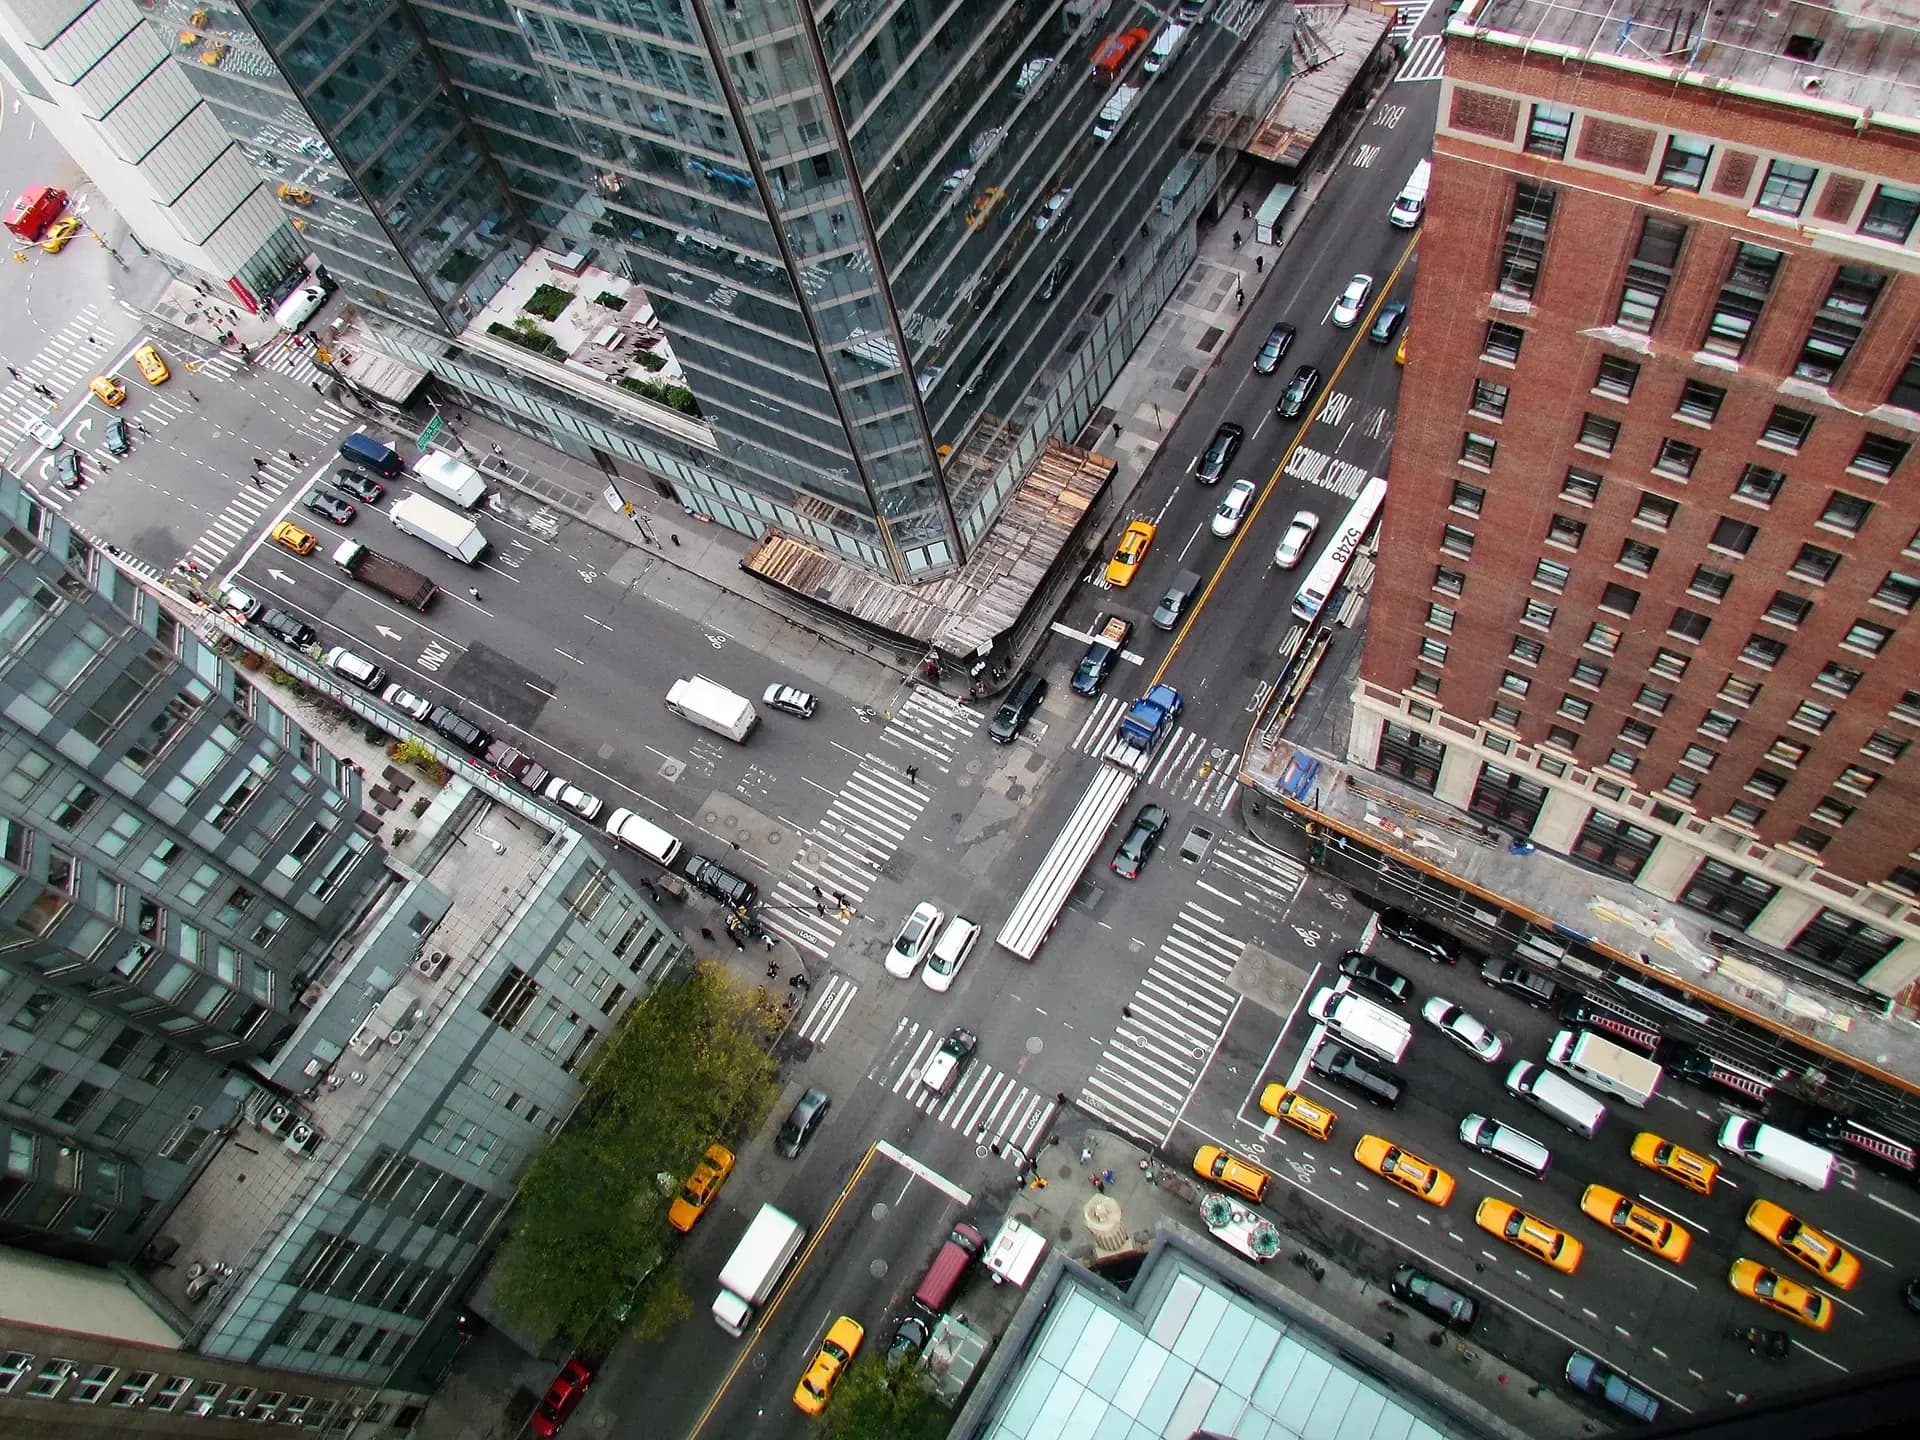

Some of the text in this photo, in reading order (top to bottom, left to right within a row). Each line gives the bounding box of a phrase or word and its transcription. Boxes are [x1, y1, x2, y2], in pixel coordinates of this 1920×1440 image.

[1373, 104, 1406, 129] BUS
[1284, 445, 1368, 500] SCHOOL SCHOOL
[499, 540, 533, 568] OY
[1331, 527, 1362, 563] 5248
[417, 641, 450, 671] ONLY
